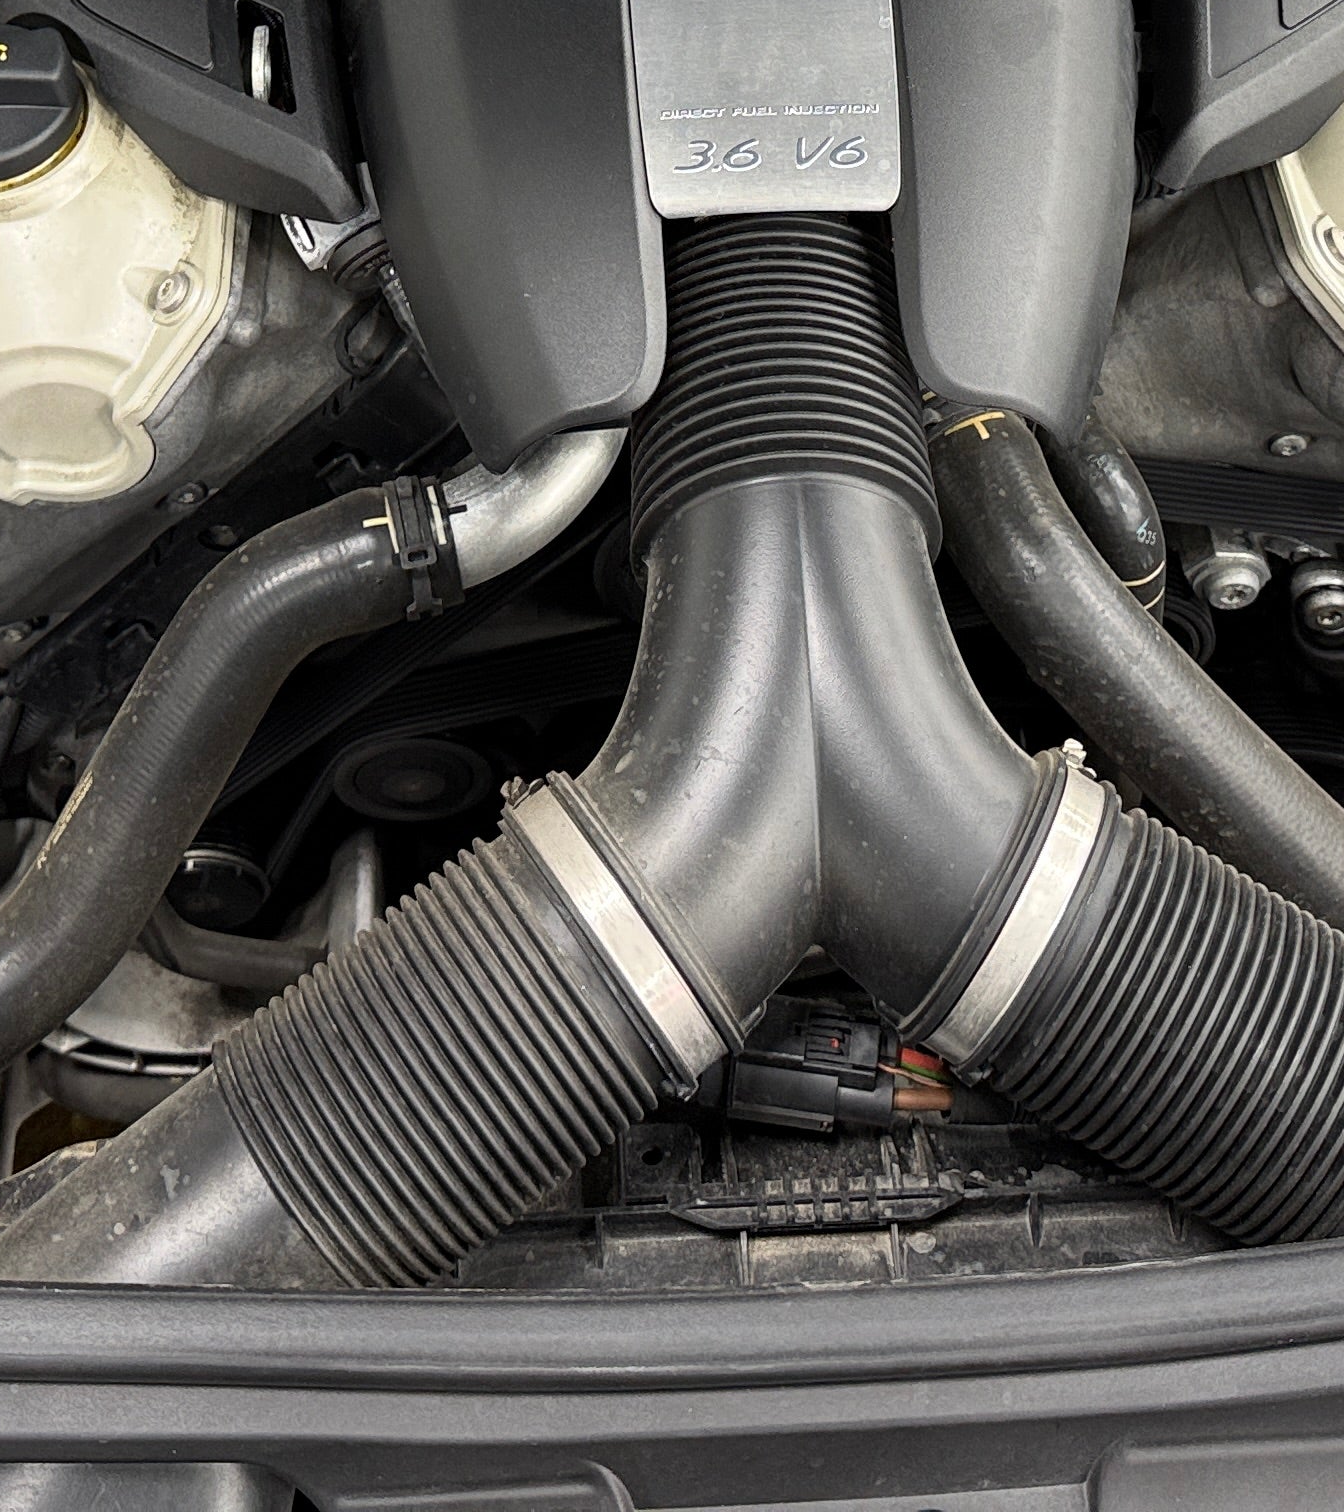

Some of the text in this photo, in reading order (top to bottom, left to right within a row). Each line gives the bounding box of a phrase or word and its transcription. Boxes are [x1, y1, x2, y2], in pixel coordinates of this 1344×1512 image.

[659, 104, 880, 121] DIRECT FUEL INJECTION
[672, 135, 869, 174] 3.6 V6
